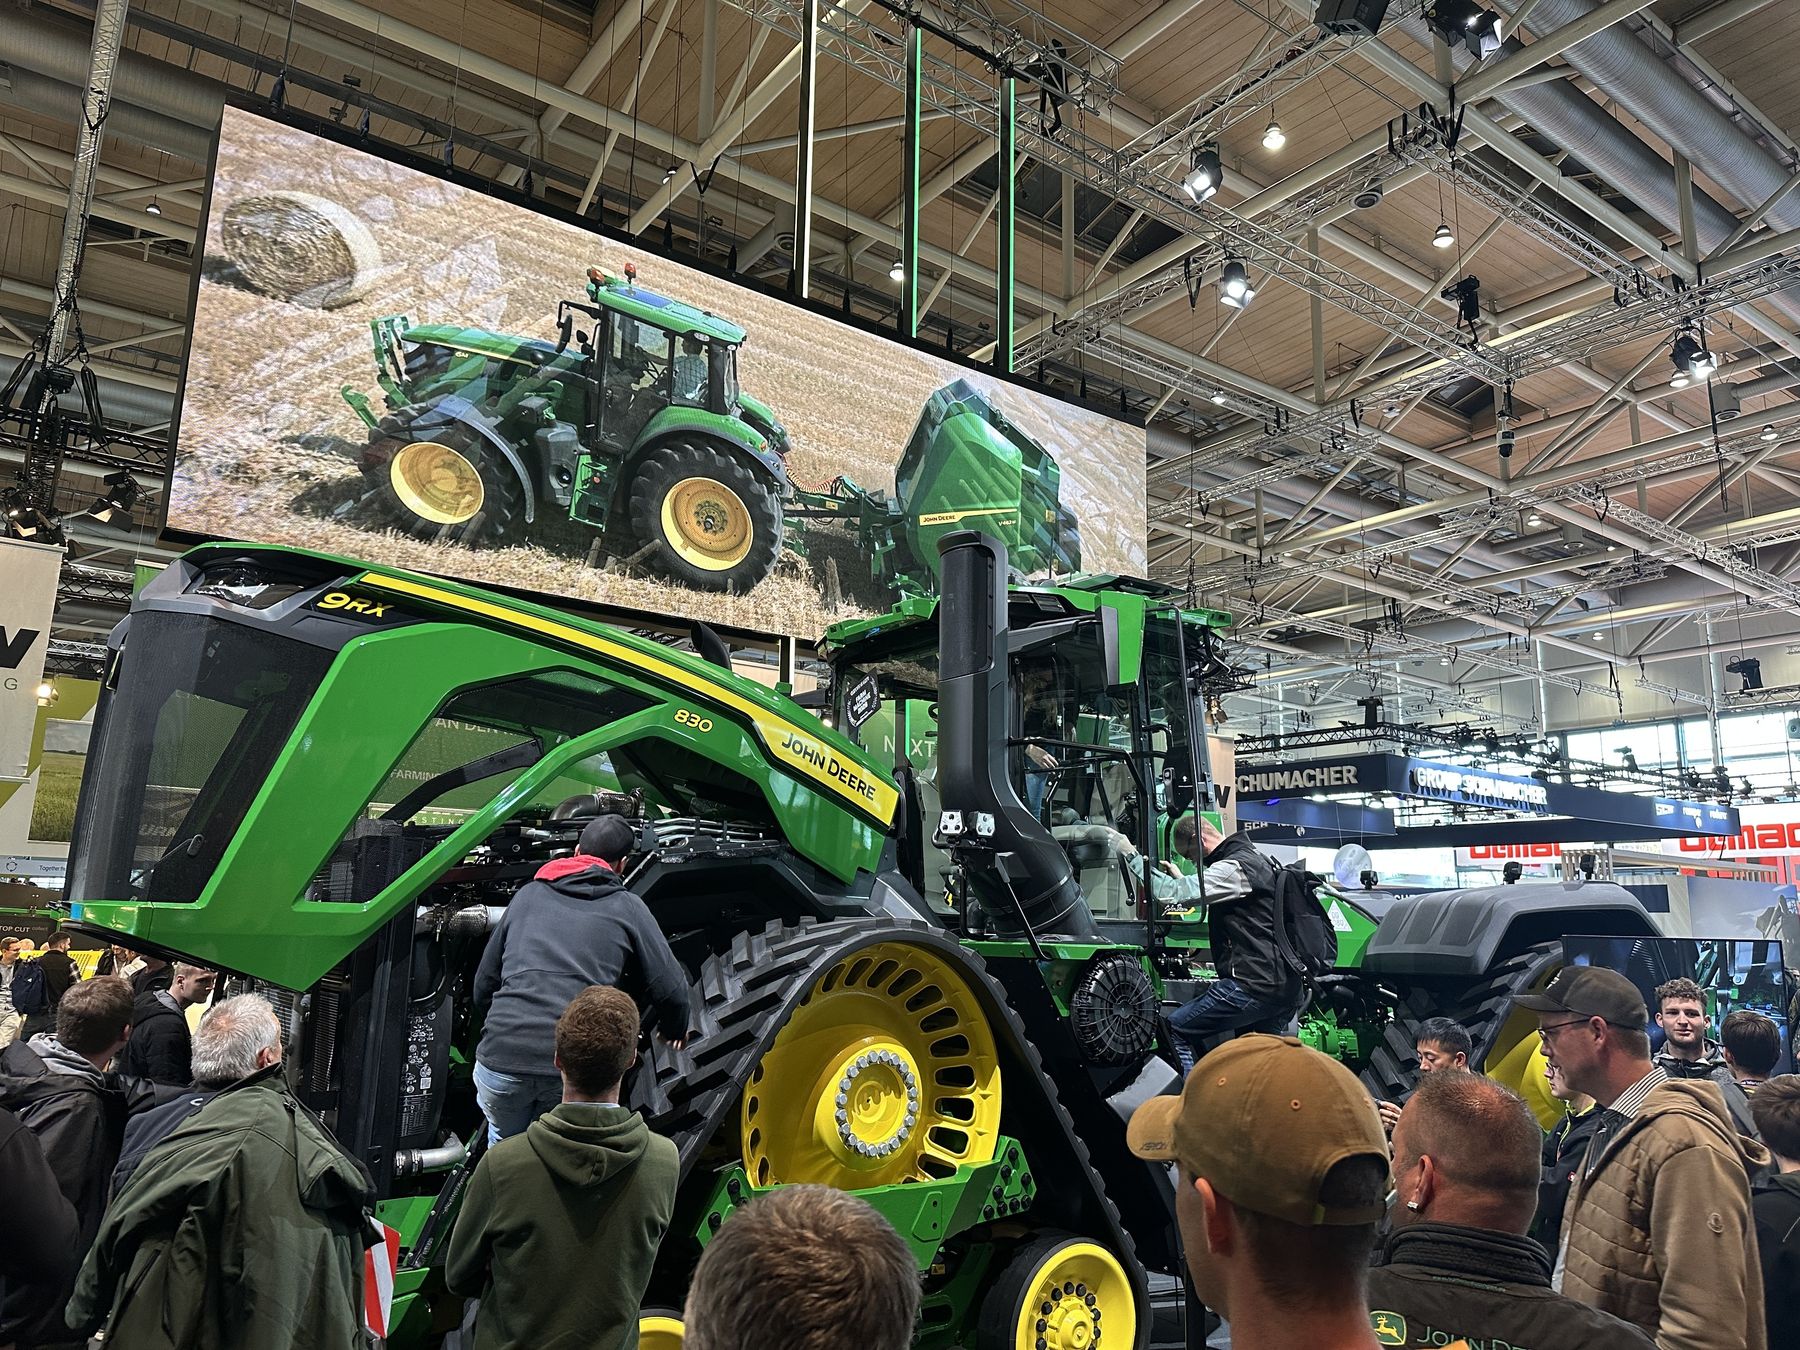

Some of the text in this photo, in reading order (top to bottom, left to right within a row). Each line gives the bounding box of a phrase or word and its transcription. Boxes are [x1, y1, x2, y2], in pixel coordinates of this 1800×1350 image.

[923, 515, 938, 523] JOHN
[316, 592, 395, 618] 9RX
[673, 709, 714, 733] 830
[883, 735, 937, 758] NXT
[390, 768, 440, 782] FARMIN
[781, 732, 877, 802] JOHN DEERE
[1236, 765, 1358, 793] CHUMACHER
[40, 864, 59, 872] Together
[1416, 1326, 1484, 1350] JON
